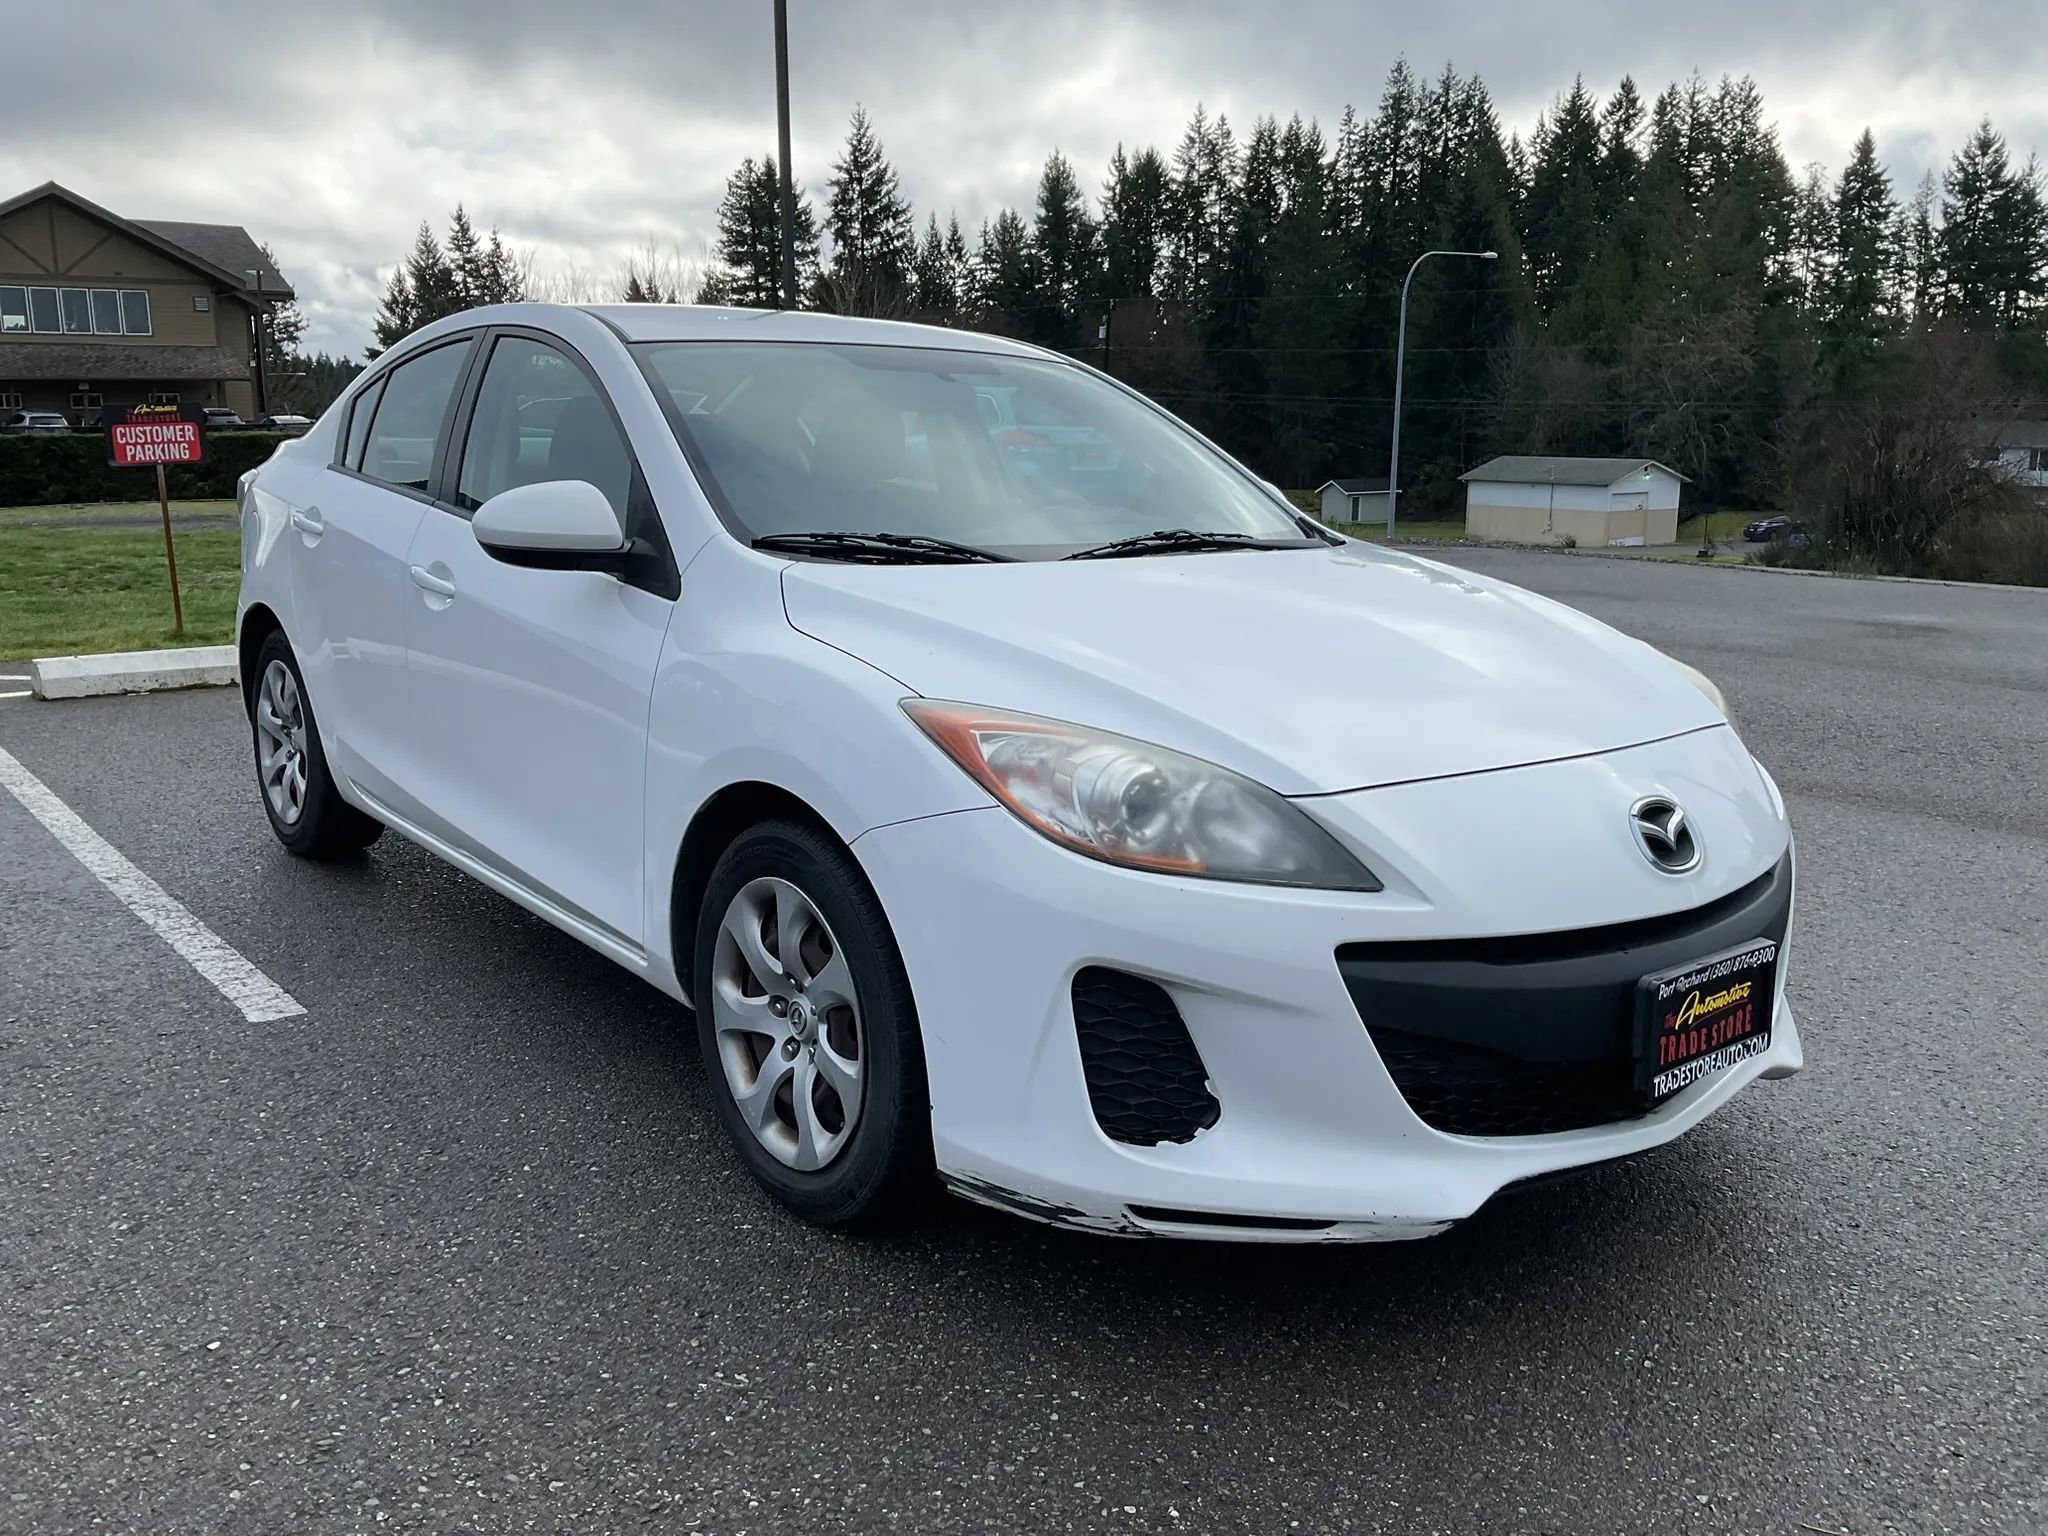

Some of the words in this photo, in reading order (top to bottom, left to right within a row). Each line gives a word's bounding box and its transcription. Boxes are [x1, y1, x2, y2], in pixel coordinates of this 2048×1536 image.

[116, 425, 194, 444] CUSTOMER
[126, 443, 190, 461] PARKING
[1659, 980, 1675, 1000] Port
[1676, 967, 1711, 993] Orchard
[1710, 959, 1734, 981] (360)
[1675, 982, 1752, 1030] Automotive
[1660, 1028, 1707, 1065] TRADE
[1712, 1004, 1752, 1047] STORE
[1654, 1032, 1768, 1098] TRADESTOREAUTO.COM
